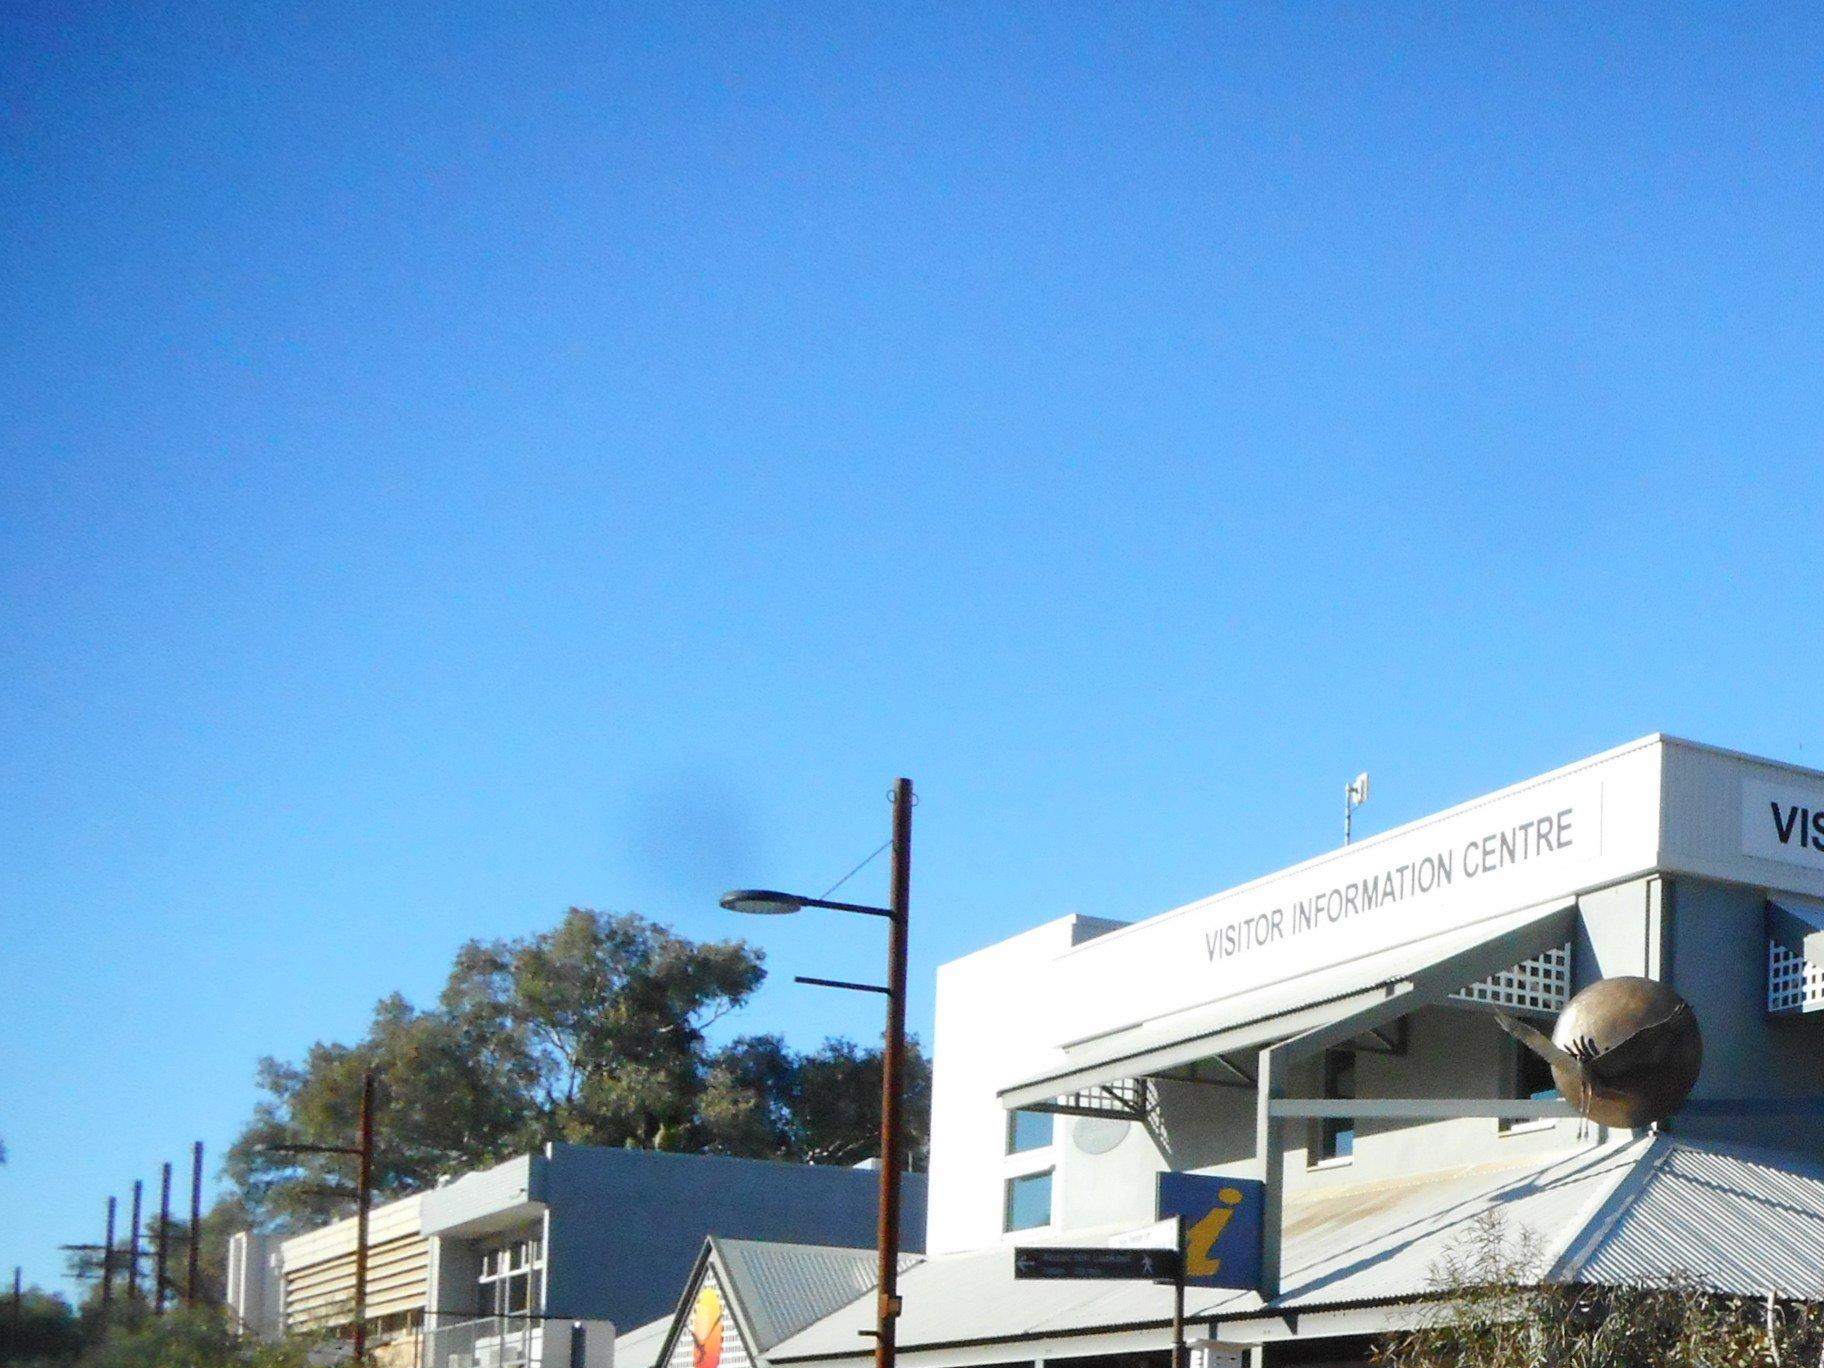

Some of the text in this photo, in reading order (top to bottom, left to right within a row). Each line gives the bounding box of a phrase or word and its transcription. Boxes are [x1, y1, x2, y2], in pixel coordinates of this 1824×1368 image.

[1205, 808, 1574, 962] VISITOR INFORMATION CENTRE
